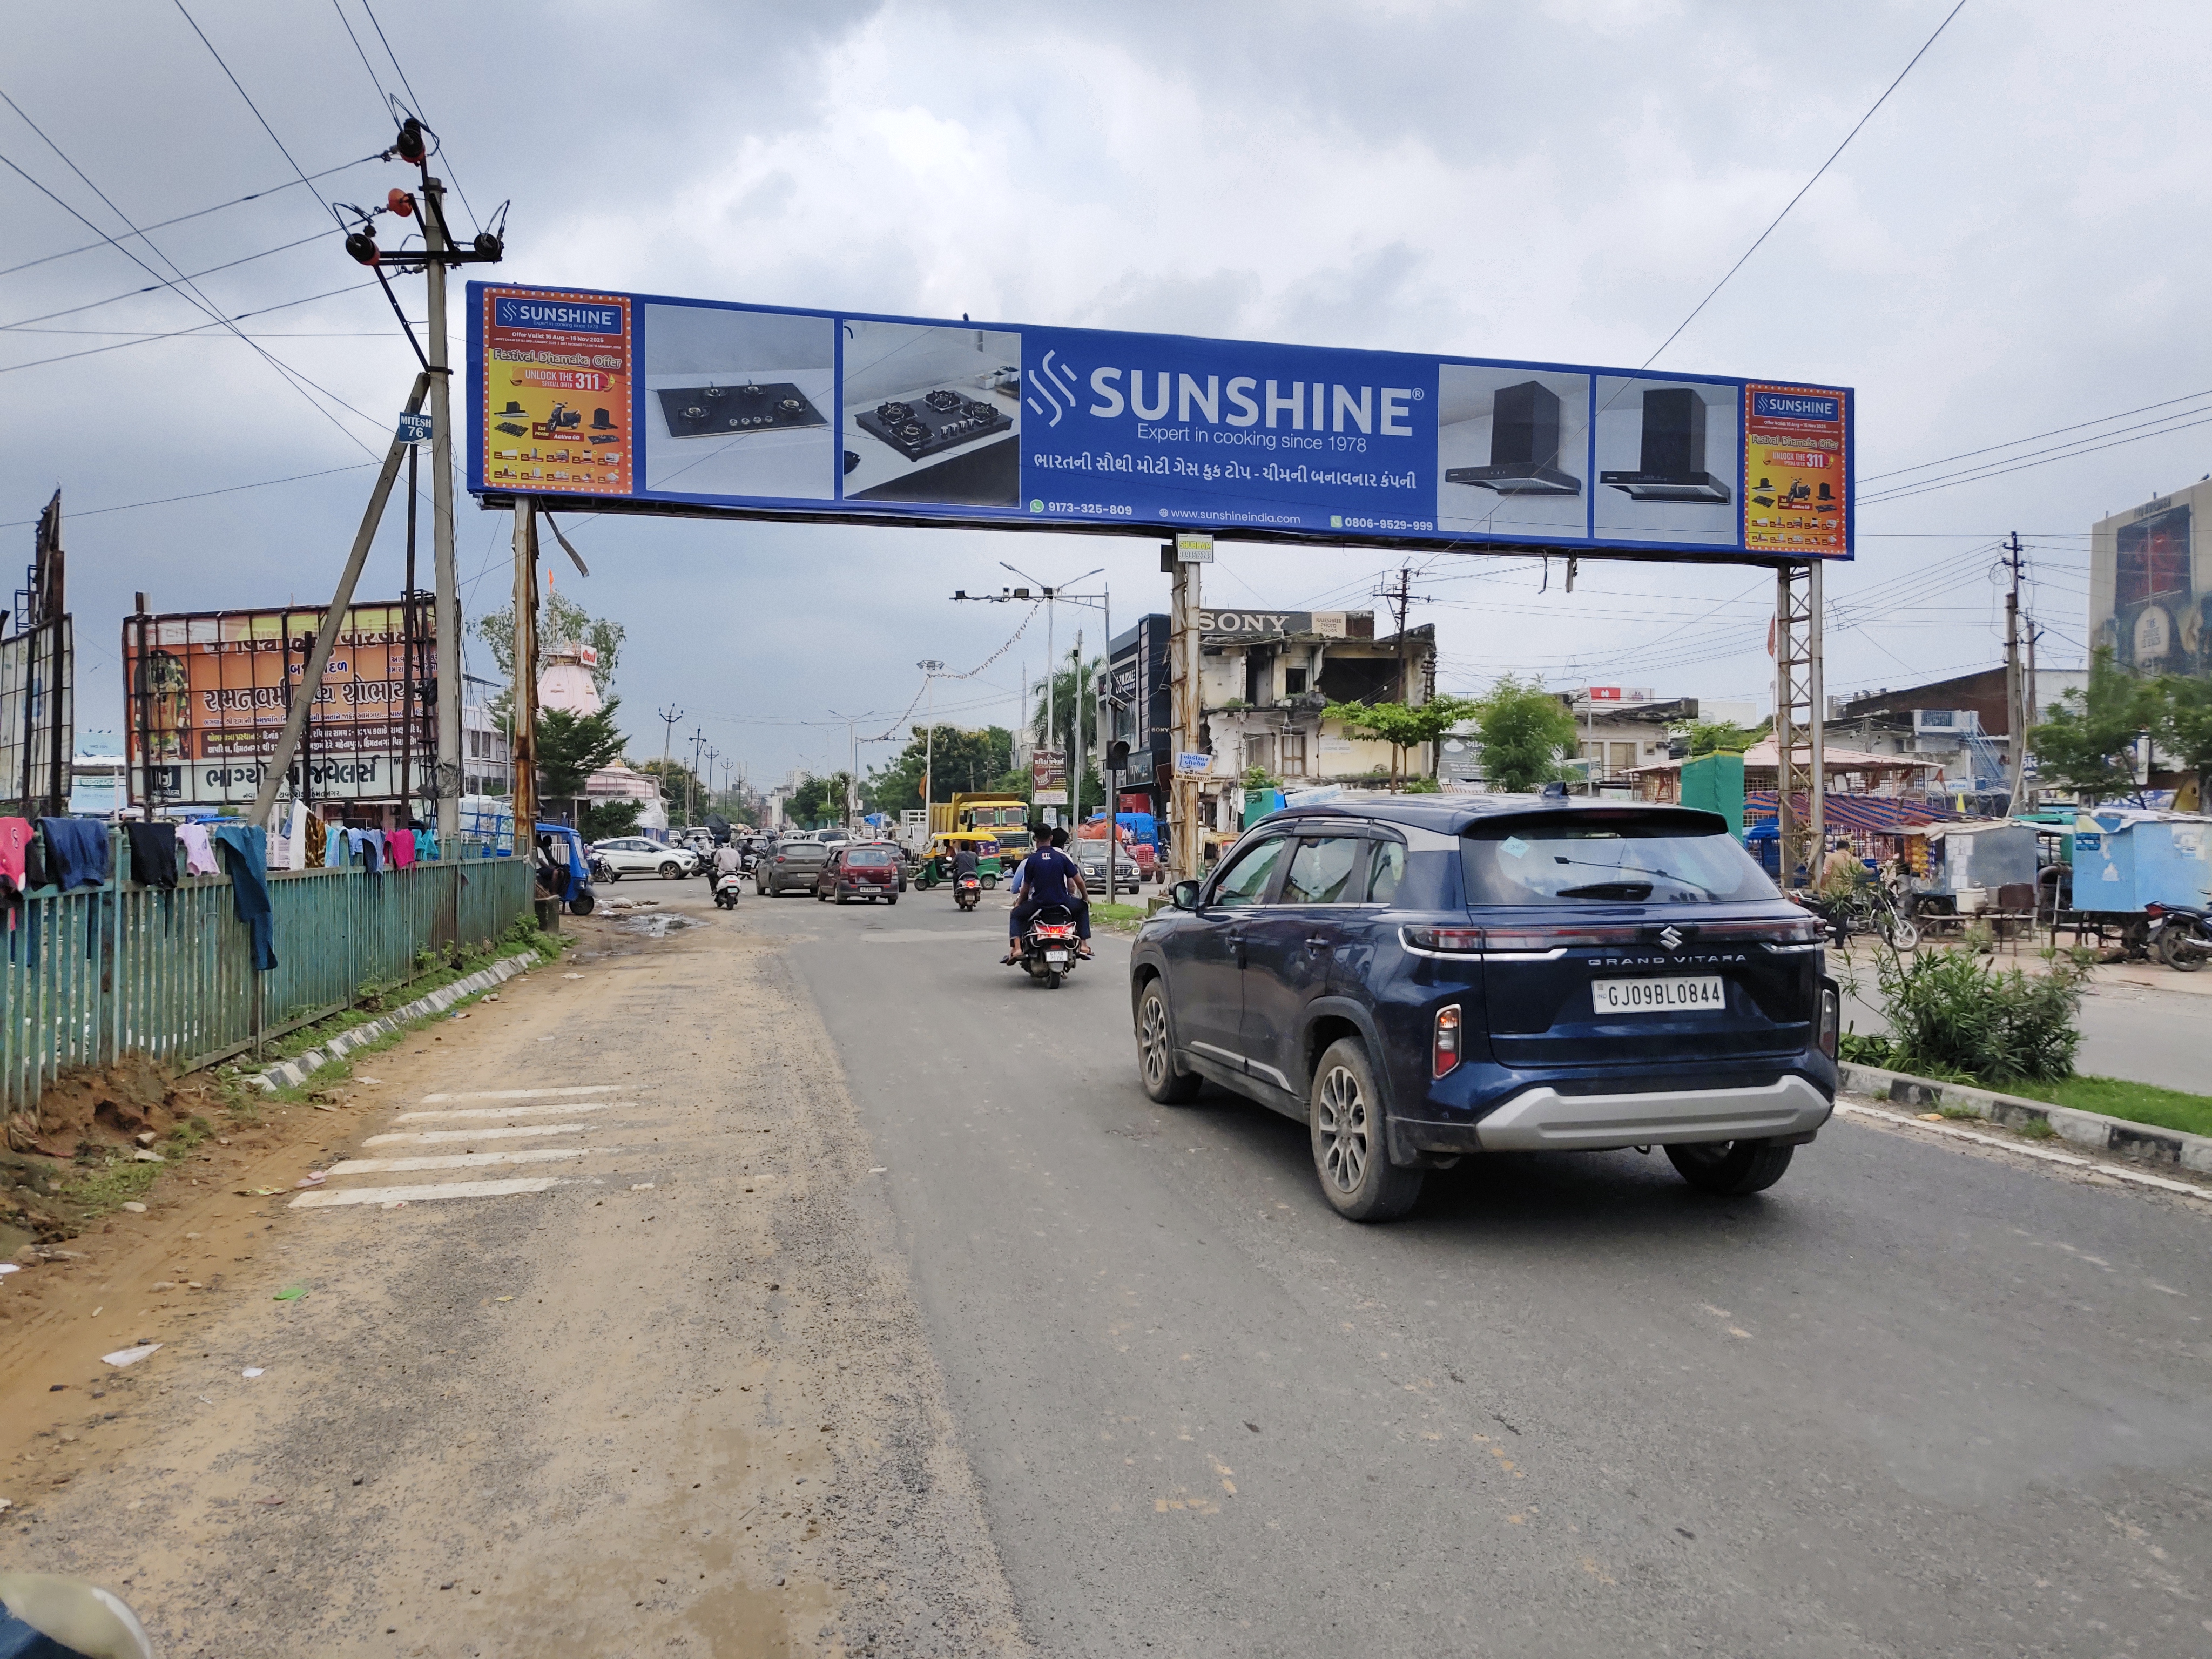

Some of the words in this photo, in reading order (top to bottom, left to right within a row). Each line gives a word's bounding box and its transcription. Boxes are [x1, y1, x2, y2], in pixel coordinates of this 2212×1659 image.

[520, 306, 612, 325] SUNSHINE
[494, 348, 535, 362] Festival
[537, 350, 590, 367] Dhamaka
[593, 356, 622, 369] Offer
[525, 369, 556, 381] UNLOCK
[559, 372, 573, 382] THE
[575, 373, 599, 389] 311
[1089, 367, 1413, 436] SUNSHINE
[1770, 399, 1832, 414] SUNSHINE
[401, 415, 431, 428] MITESH
[408, 426, 424, 437] 76
[1138, 423, 1190, 444] Expert
[1195, 428, 1208, 442] in
[1213, 429, 1276, 450] cooking
[1281, 435, 1322, 450] since
[1328, 436, 1366, 453] 1978
[1752, 434, 1779, 446] Festival
[1782, 436, 1817, 448] Dhamaka
[1819, 438, 1839, 450] Offer
[1772, 451, 1794, 461] UNLOCK
[1795, 453, 1805, 461] THE
[1806, 453, 1823, 468] 311
[1034, 452, 1092, 470] ભારતની
[1096, 452, 1133, 473] સૌથી
[1137, 456, 1170, 475] મોટી
[1173, 458, 1199, 476] ગેસ
[1203, 464, 1221, 481] કુક
[1225, 461, 1251, 480] ટોપ
[1262, 463, 1307, 483] ચીમની
[1311, 469, 1377, 487] બનાવનાર
[1380, 470, 1417, 489] કંપની
[1048, 502, 1132, 515] 9173-325-809
[1170, 509, 1300, 524] www.sunshineindia.com
[1345, 517, 1433, 531] 0806-9529-999
[1179, 541, 1211, 550] SHUBHAM
[1179, 550, 1211, 559] 9898512345
[1199, 612, 1290, 632] SONY
[1588, 957, 1665, 966] GRAND
[1674, 955, 1746, 965] VITARA
[1608, 982, 1719, 1006] GJ09BL0844
